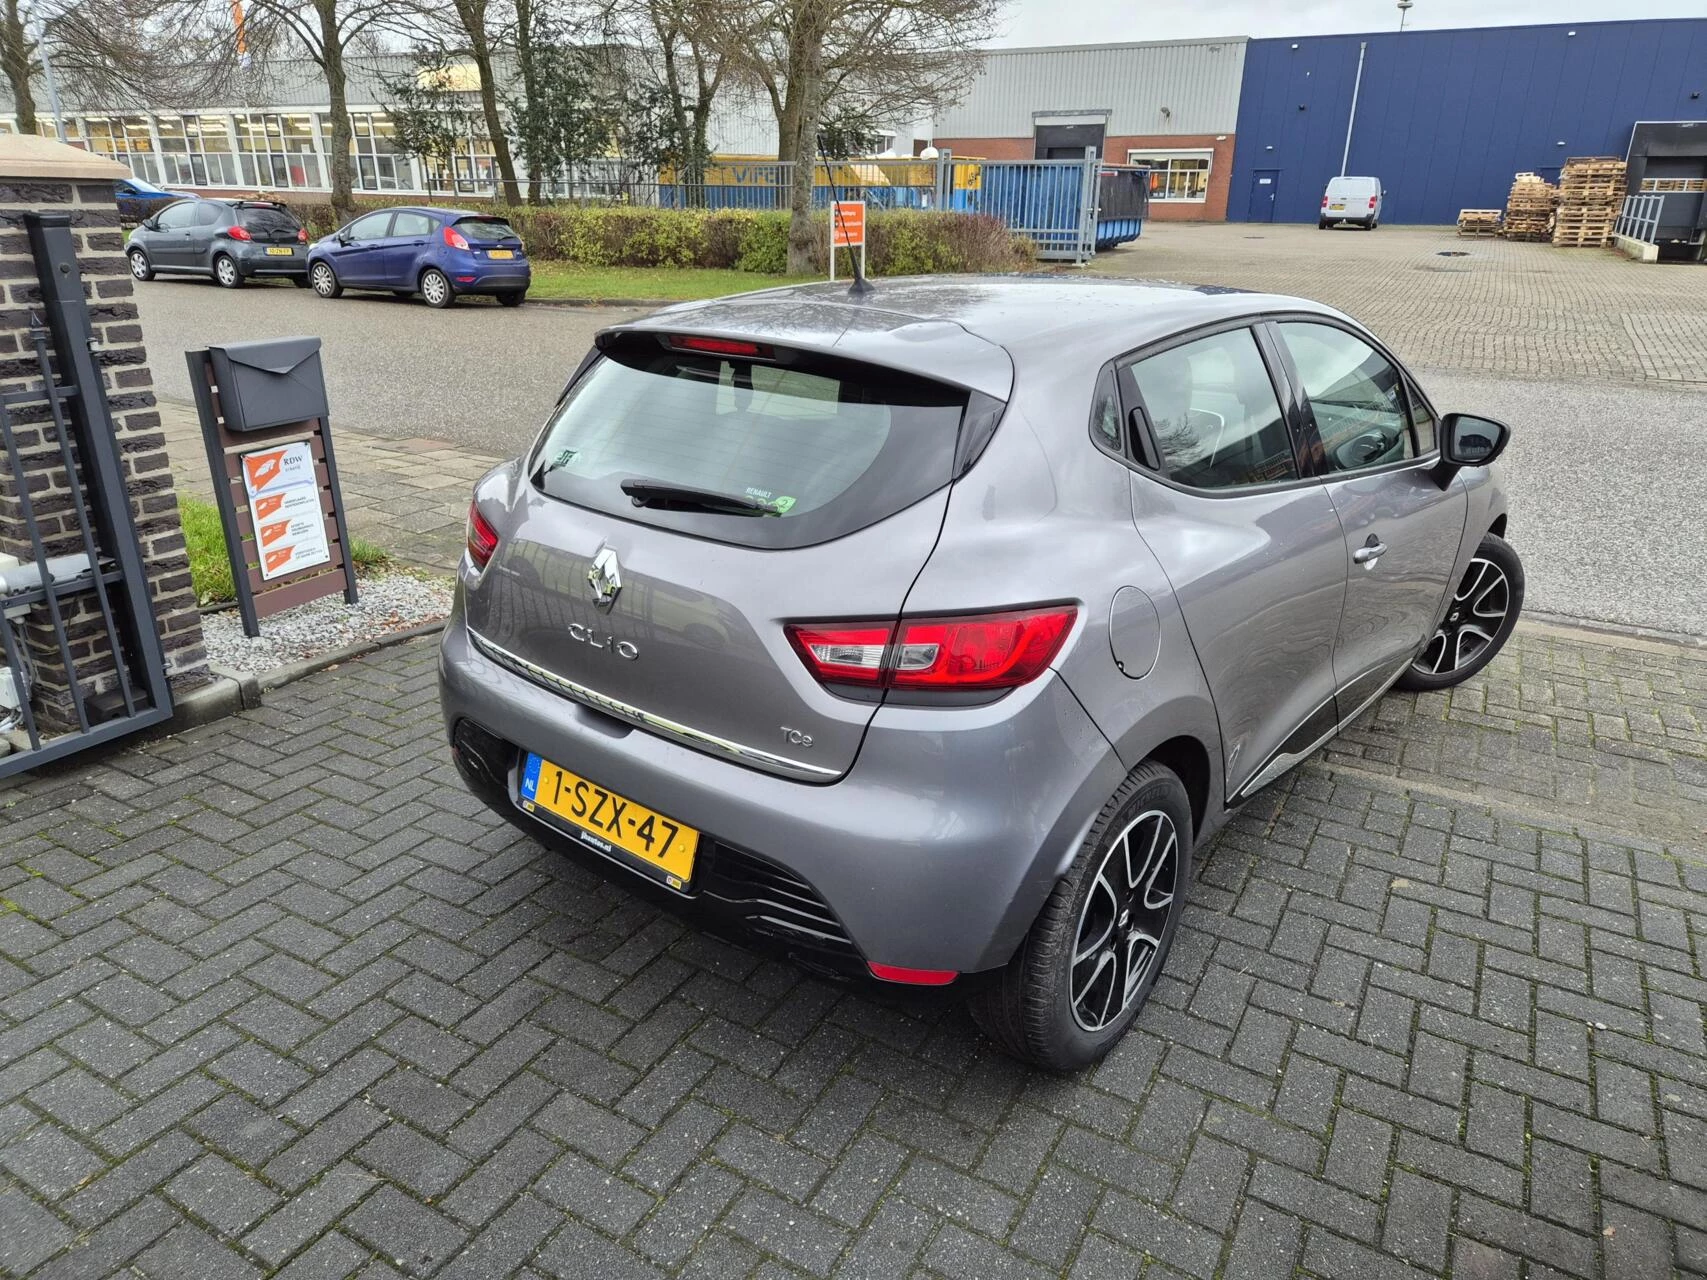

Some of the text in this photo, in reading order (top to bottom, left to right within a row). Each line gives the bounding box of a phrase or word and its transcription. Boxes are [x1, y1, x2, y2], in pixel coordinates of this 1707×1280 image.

[283, 455, 303, 466] RDW
[745, 487, 772, 499] RENAULT
[567, 622, 639, 660] CLIO
[780, 726, 814, 748] TCe
[524, 778, 536, 793] NL
[553, 770, 680, 859] 1-SZX-47
